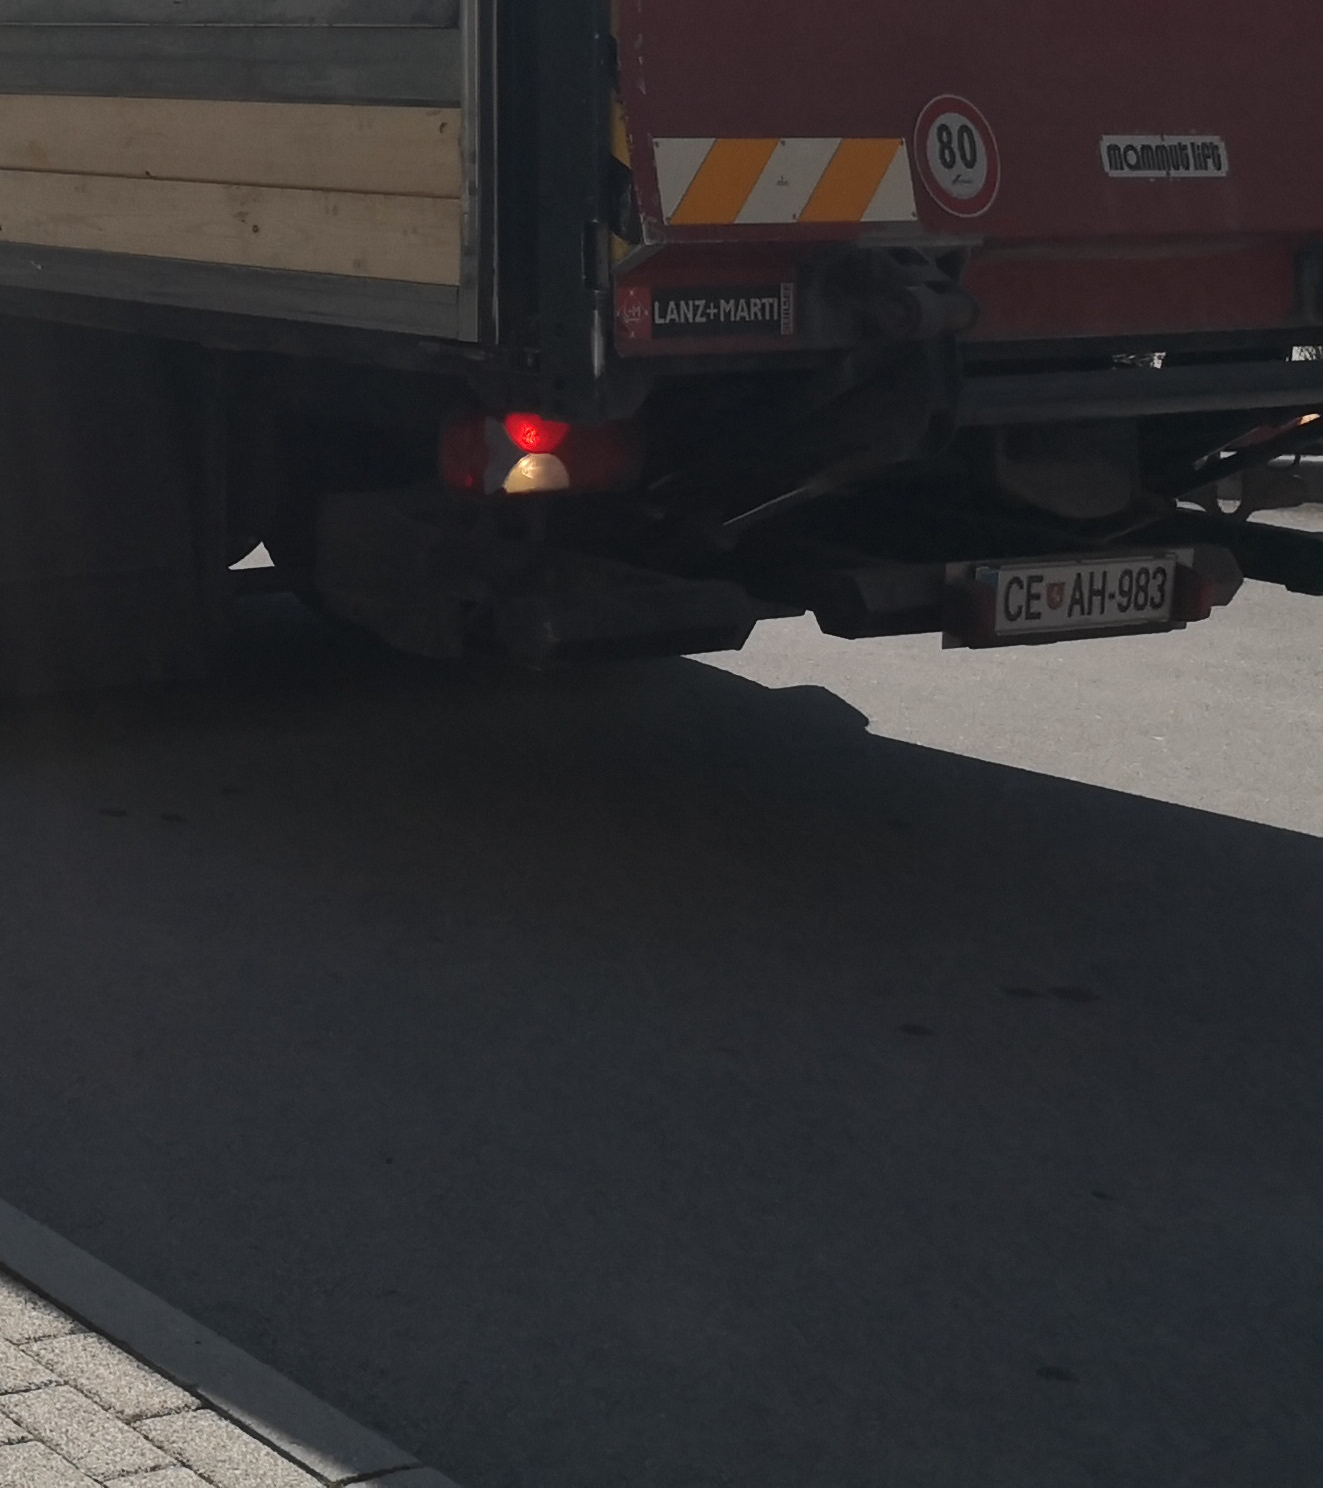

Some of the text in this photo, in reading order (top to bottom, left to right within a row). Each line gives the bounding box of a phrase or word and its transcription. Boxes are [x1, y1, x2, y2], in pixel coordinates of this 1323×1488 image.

[936, 123, 978, 170] 80
[654, 297, 779, 325] LANZ+MARTI
[1005, 566, 1167, 622] CE AH-983
